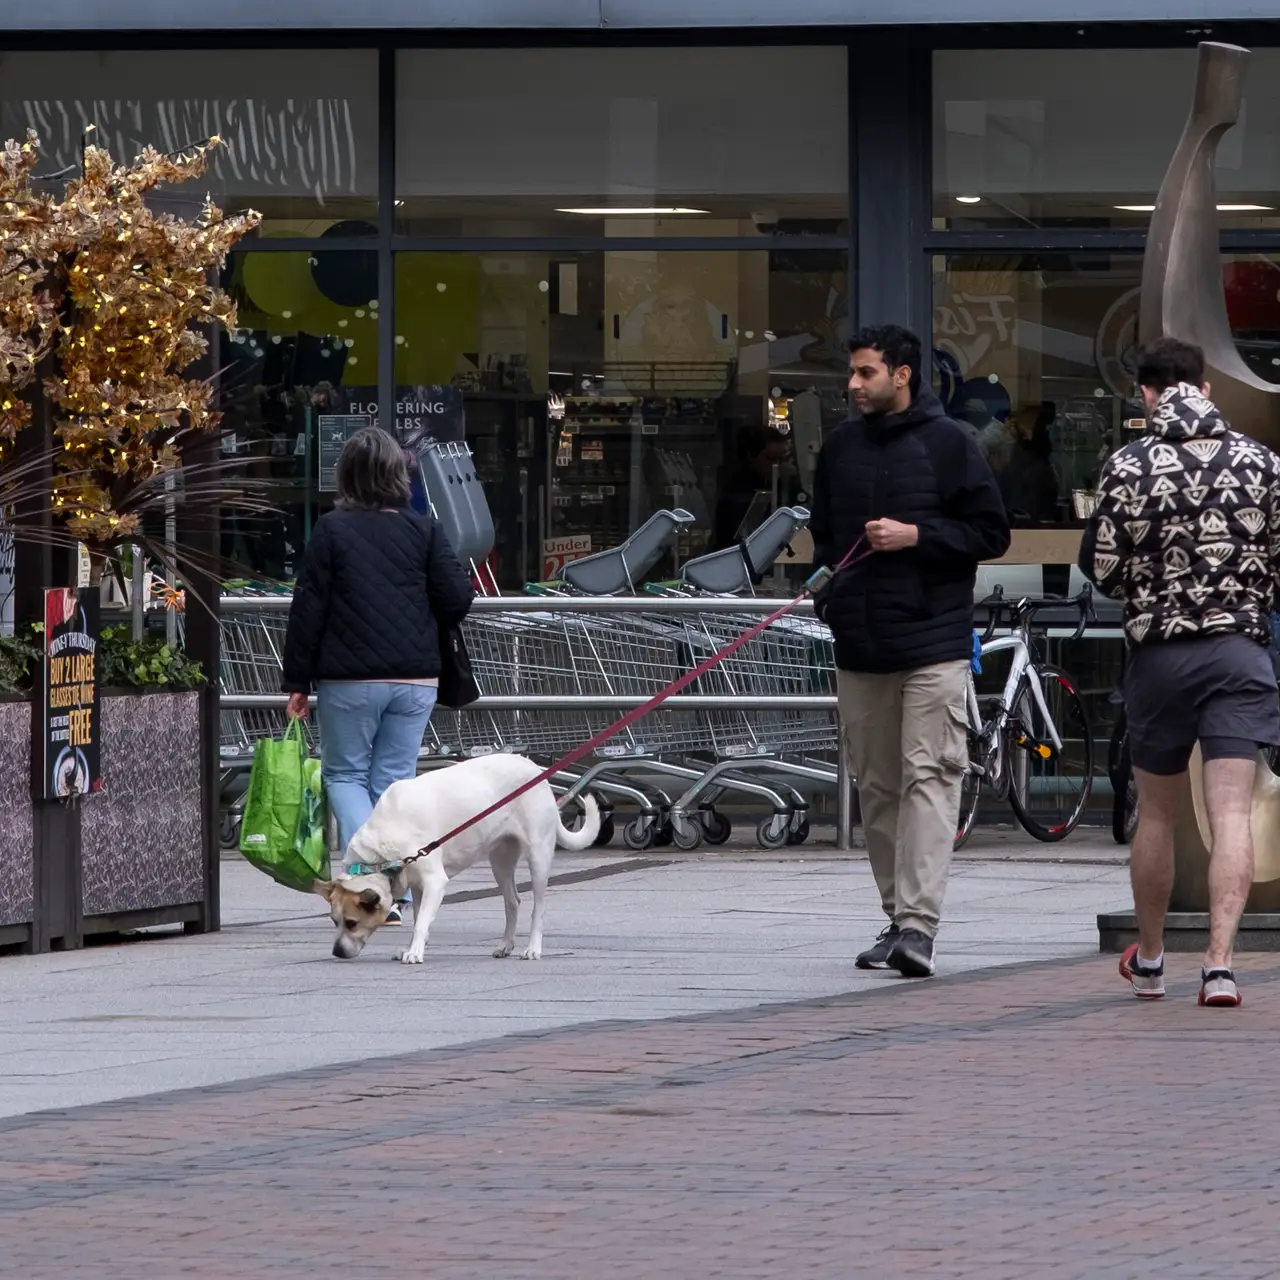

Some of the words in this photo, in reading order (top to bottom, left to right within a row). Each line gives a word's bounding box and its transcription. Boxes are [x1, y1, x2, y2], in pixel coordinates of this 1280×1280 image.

[350, 402, 445, 414] FLOERING
[545, 539, 589, 553] Under
[50, 656, 64, 685] BUY
[65, 656, 71, 683] 2
[71, 654, 95, 682] LARGE
[50, 685, 71, 708] GLASSES
[71, 684, 80, 706] OF
[80, 683, 95, 705] WINE
[69, 708, 92, 747] FREE
